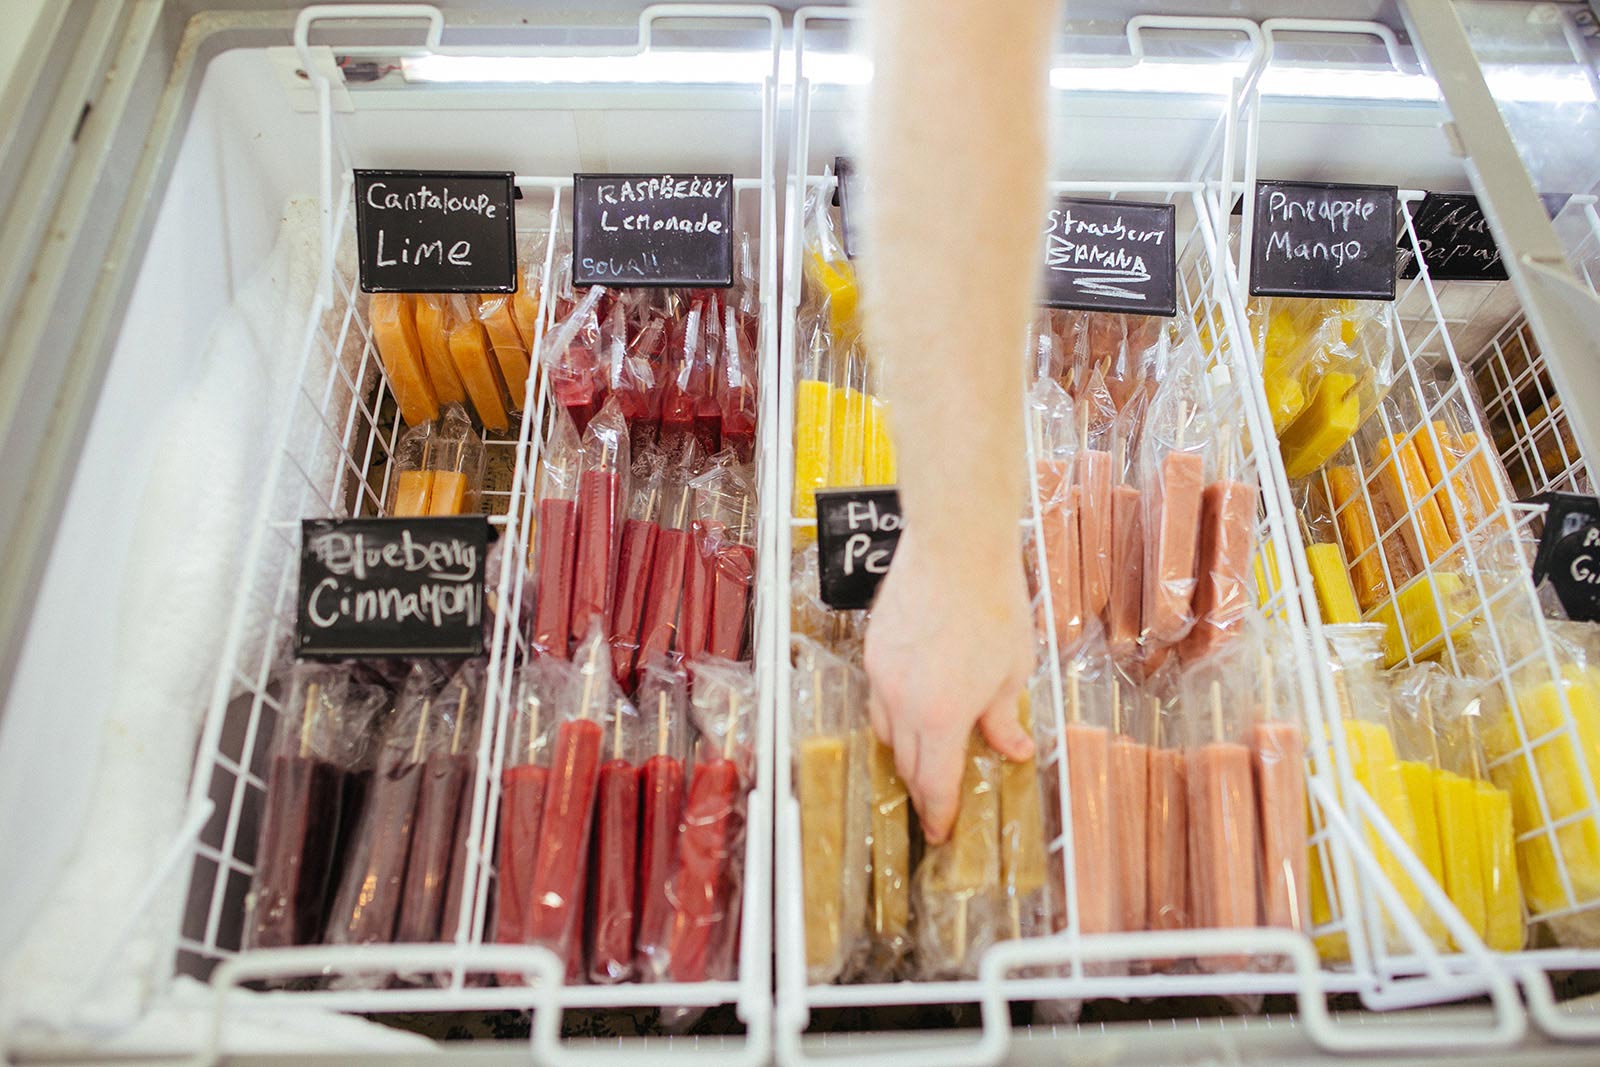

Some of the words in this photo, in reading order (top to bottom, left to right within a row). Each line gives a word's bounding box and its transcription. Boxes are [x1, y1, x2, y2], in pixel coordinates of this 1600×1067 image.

[366, 182, 497, 219] Cantaloupe
[597, 174, 728, 205] RASPBERRY
[1042, 209, 1165, 245] Strawberry
[1269, 191, 1375, 232] Pineapple
[1420, 202, 1492, 243] Ma
[376, 229, 473, 267] Lime
[1045, 233, 1148, 274] BANANA
[1265, 231, 1361, 268] Mango
[847, 499, 905, 531] Ho
[309, 529, 476, 581] Blueberry
[844, 532, 891, 576] Pe
[1570, 554, 1600, 584] Gi
[308, 577, 476, 628] Cinnamon
